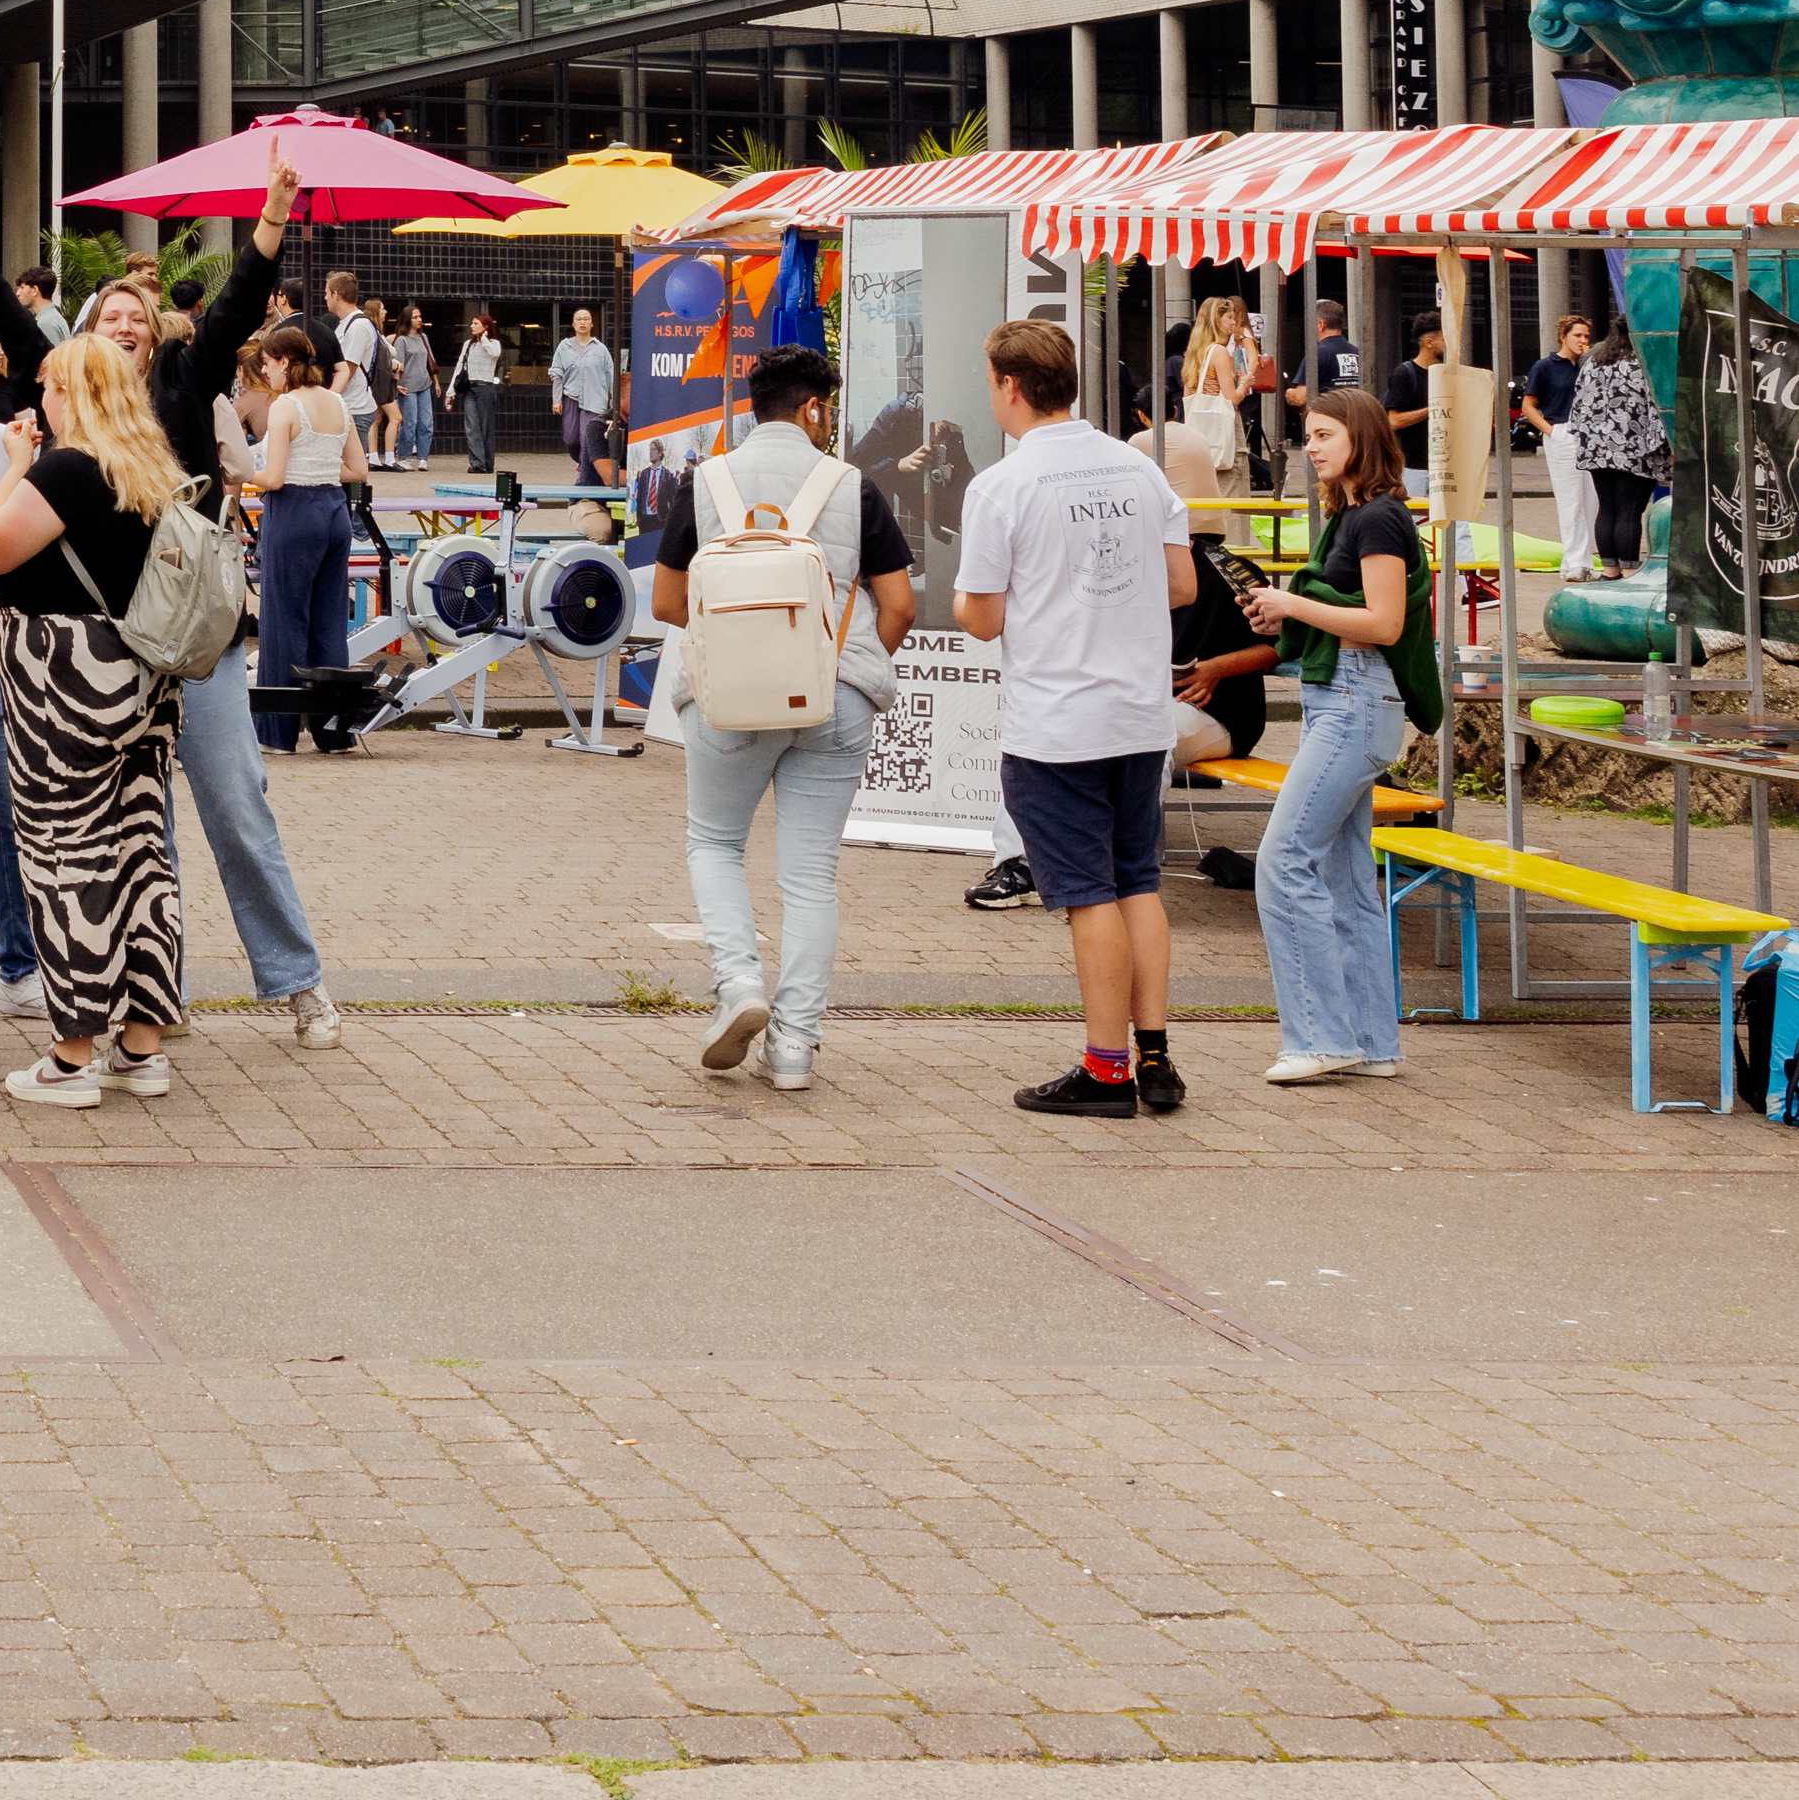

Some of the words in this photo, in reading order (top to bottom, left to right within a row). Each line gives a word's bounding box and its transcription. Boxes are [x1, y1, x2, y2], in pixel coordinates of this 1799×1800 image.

[1397, 85, 1409, 127] CAF
[654, 325, 693, 338] H.S.R.V.
[696, 325, 755, 338] PEGOS
[1750, 334, 1787, 357] .S.C.
[651, 352, 683, 377] KOM
[1429, 408, 1453, 420] TAC
[1037, 465, 1144, 485] STUDENTENVERENIGING
[1088, 489, 1112, 498] H.S.C.
[1068, 498, 1137, 523] INTAC
[1733, 550, 1799, 577] ZJNDR
[901, 635, 965, 653] OME
[894, 664, 1002, 685] EMBER
